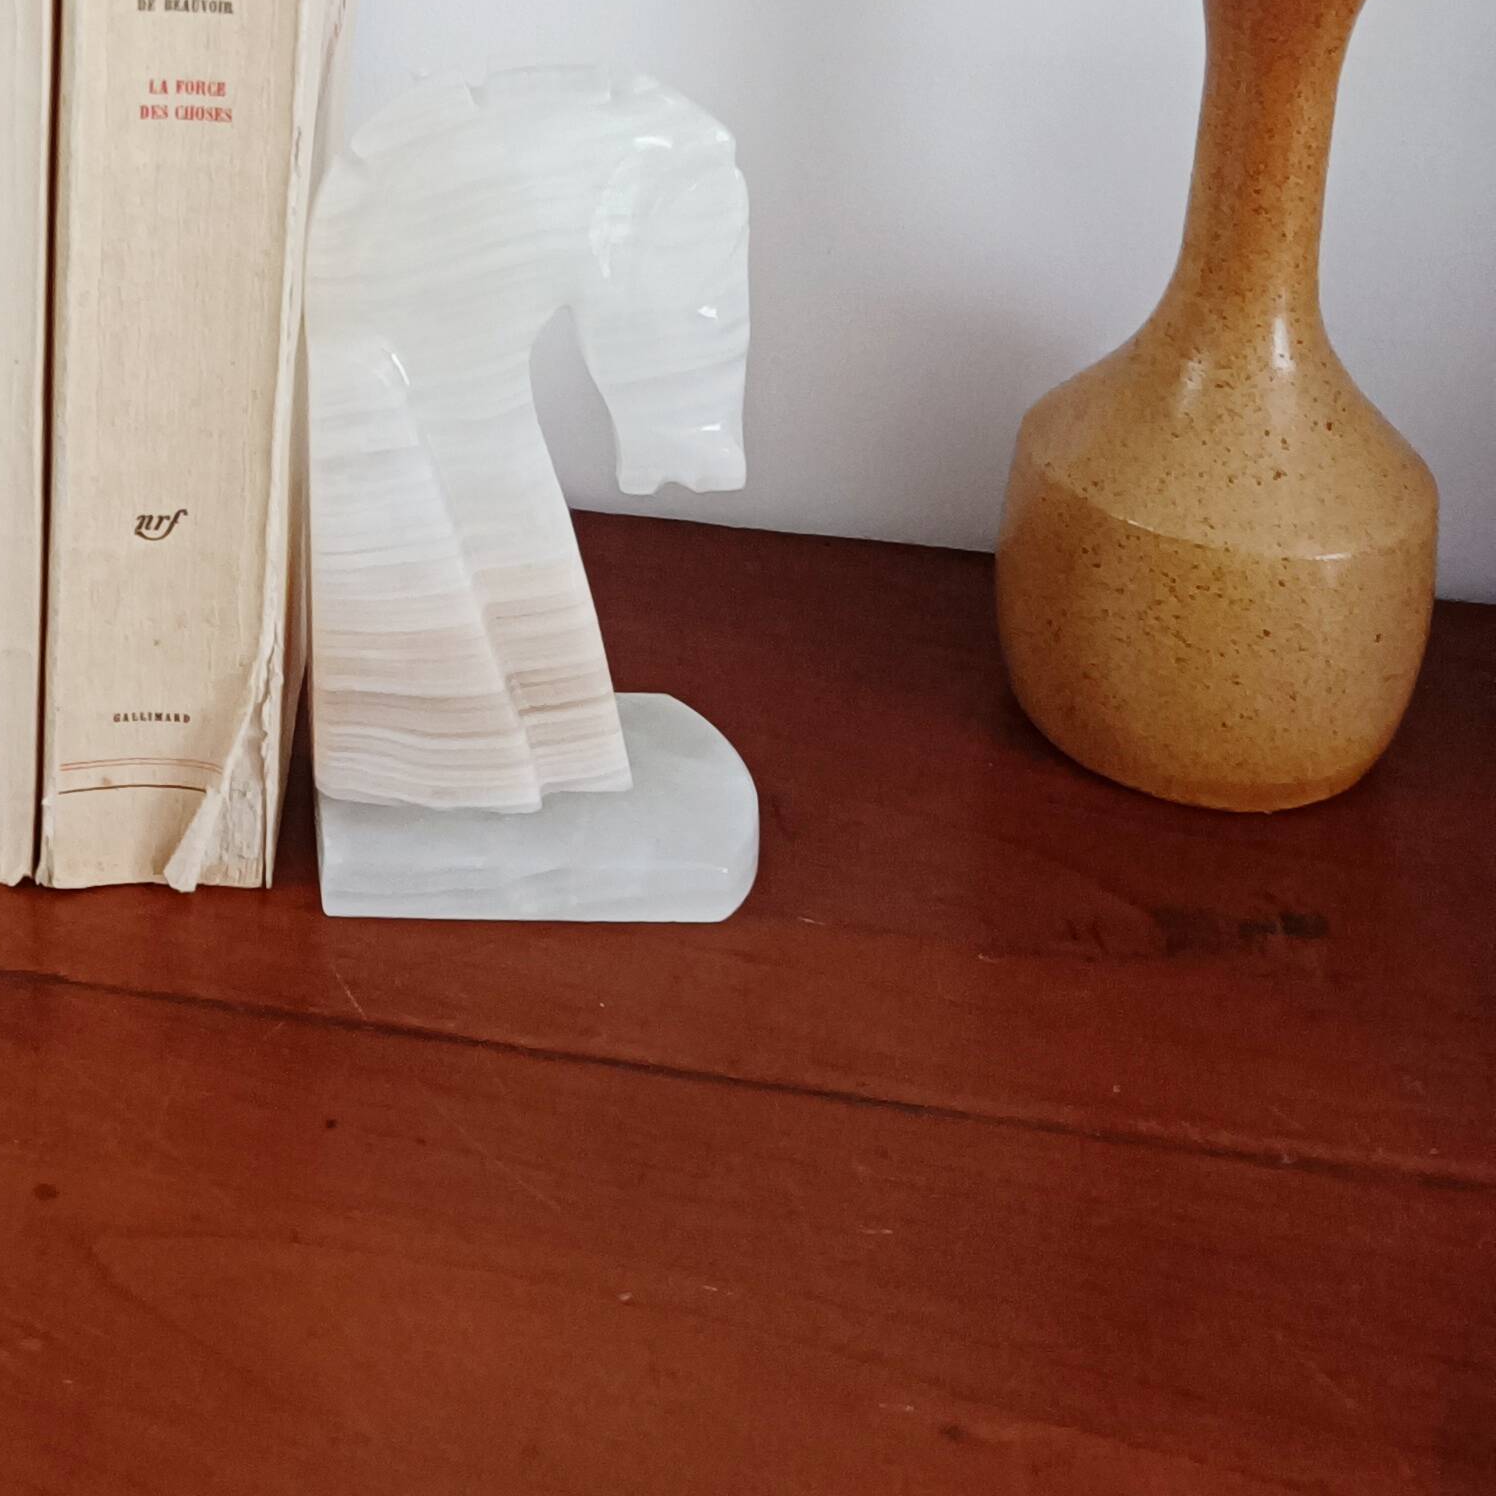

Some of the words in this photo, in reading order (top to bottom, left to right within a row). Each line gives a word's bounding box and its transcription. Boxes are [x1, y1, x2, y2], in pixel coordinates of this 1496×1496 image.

[149, 79, 169, 95] LA
[175, 79, 226, 98] FORCE
[139, 104, 169, 121] DES
[175, 105, 233, 123] CHOSES
[134, 508, 189, 541] nrf
[113, 711, 191, 724] GALLIMARD
